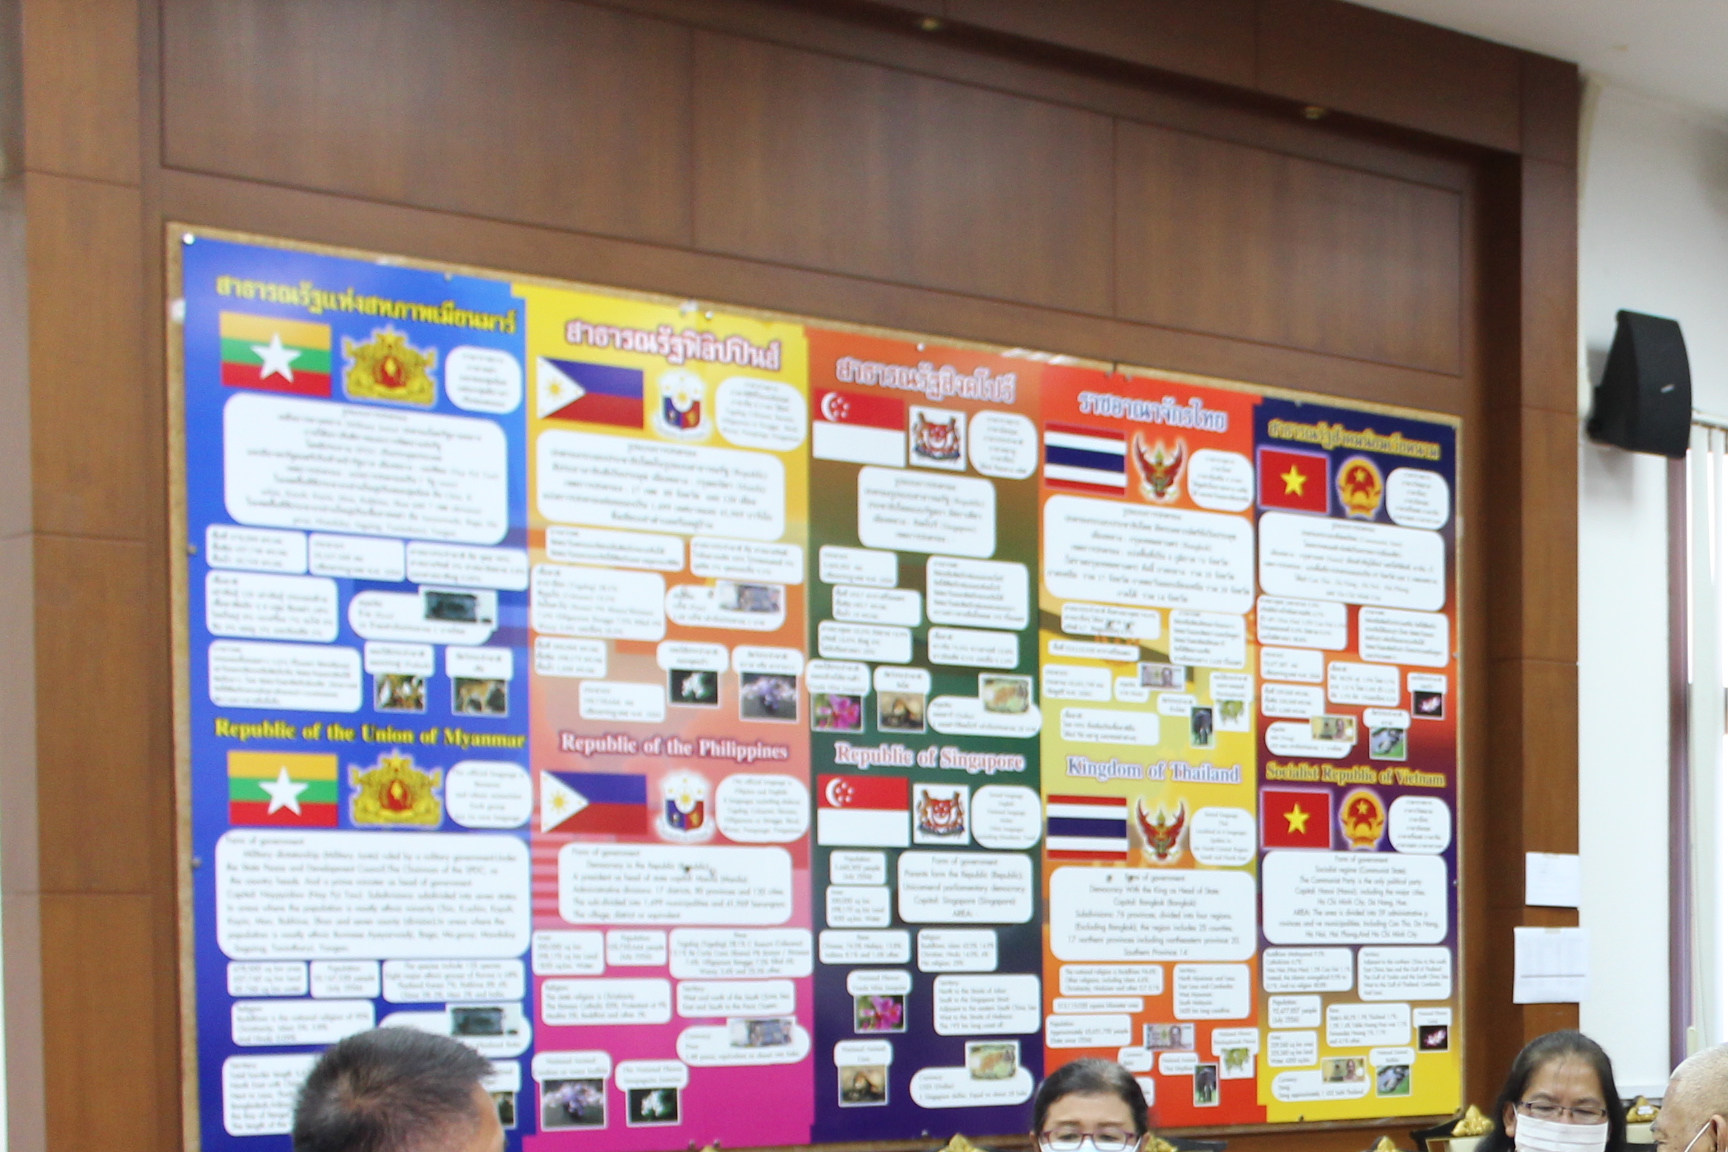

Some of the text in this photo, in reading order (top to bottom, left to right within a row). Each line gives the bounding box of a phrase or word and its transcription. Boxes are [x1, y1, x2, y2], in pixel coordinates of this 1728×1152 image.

[565, 320, 781, 371] สาธารณรัฐฟิลิปปินส์
[1077, 391, 1228, 433] ราชอาณาจักรไทย
[215, 717, 527, 750] Republic of the Union of Myanmar
[560, 732, 789, 763] Republic of the Philippines
[834, 741, 1026, 775] Republic of Singapore
[1065, 756, 1242, 785] Kingdom of Thailand
[1266, 761, 1447, 789] Socialist Republic of Vietnam
